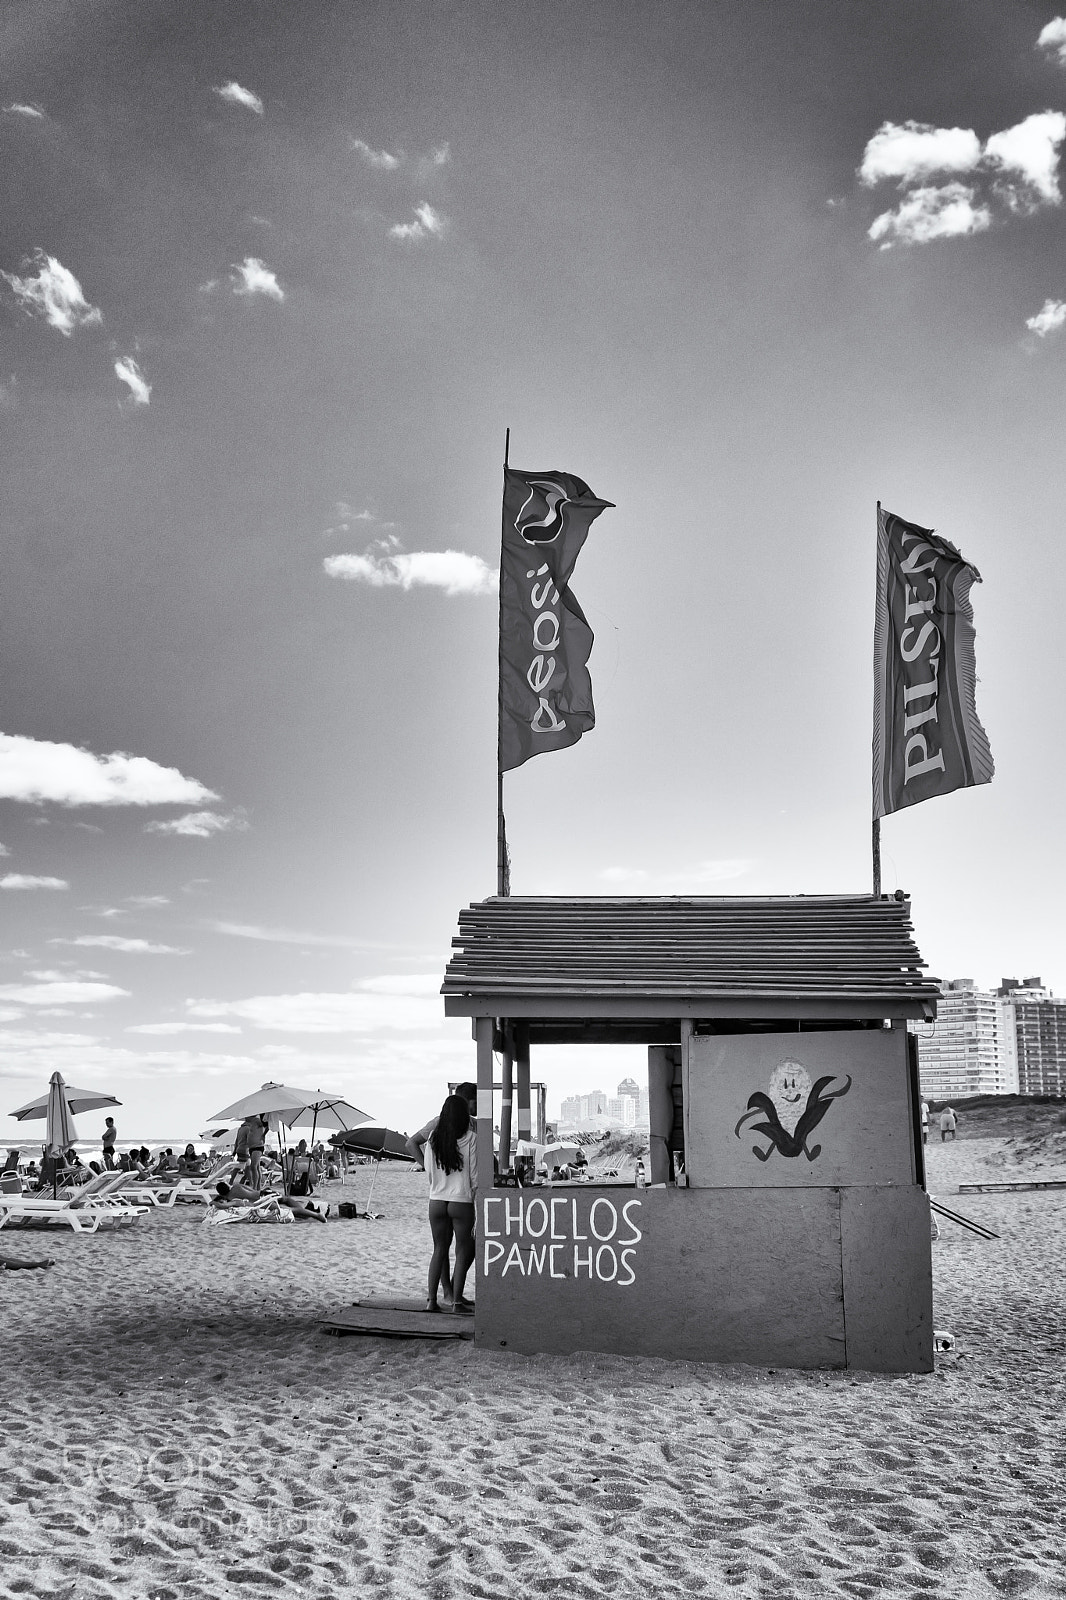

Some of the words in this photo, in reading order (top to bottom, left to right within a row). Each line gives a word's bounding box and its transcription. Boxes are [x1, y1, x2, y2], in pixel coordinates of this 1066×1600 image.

[526, 562, 566, 733] pepsi
[900, 530, 947, 786] PILSEN
[483, 1196, 643, 1246] CHOCLOS
[483, 1240, 637, 1286] PANCHOS
